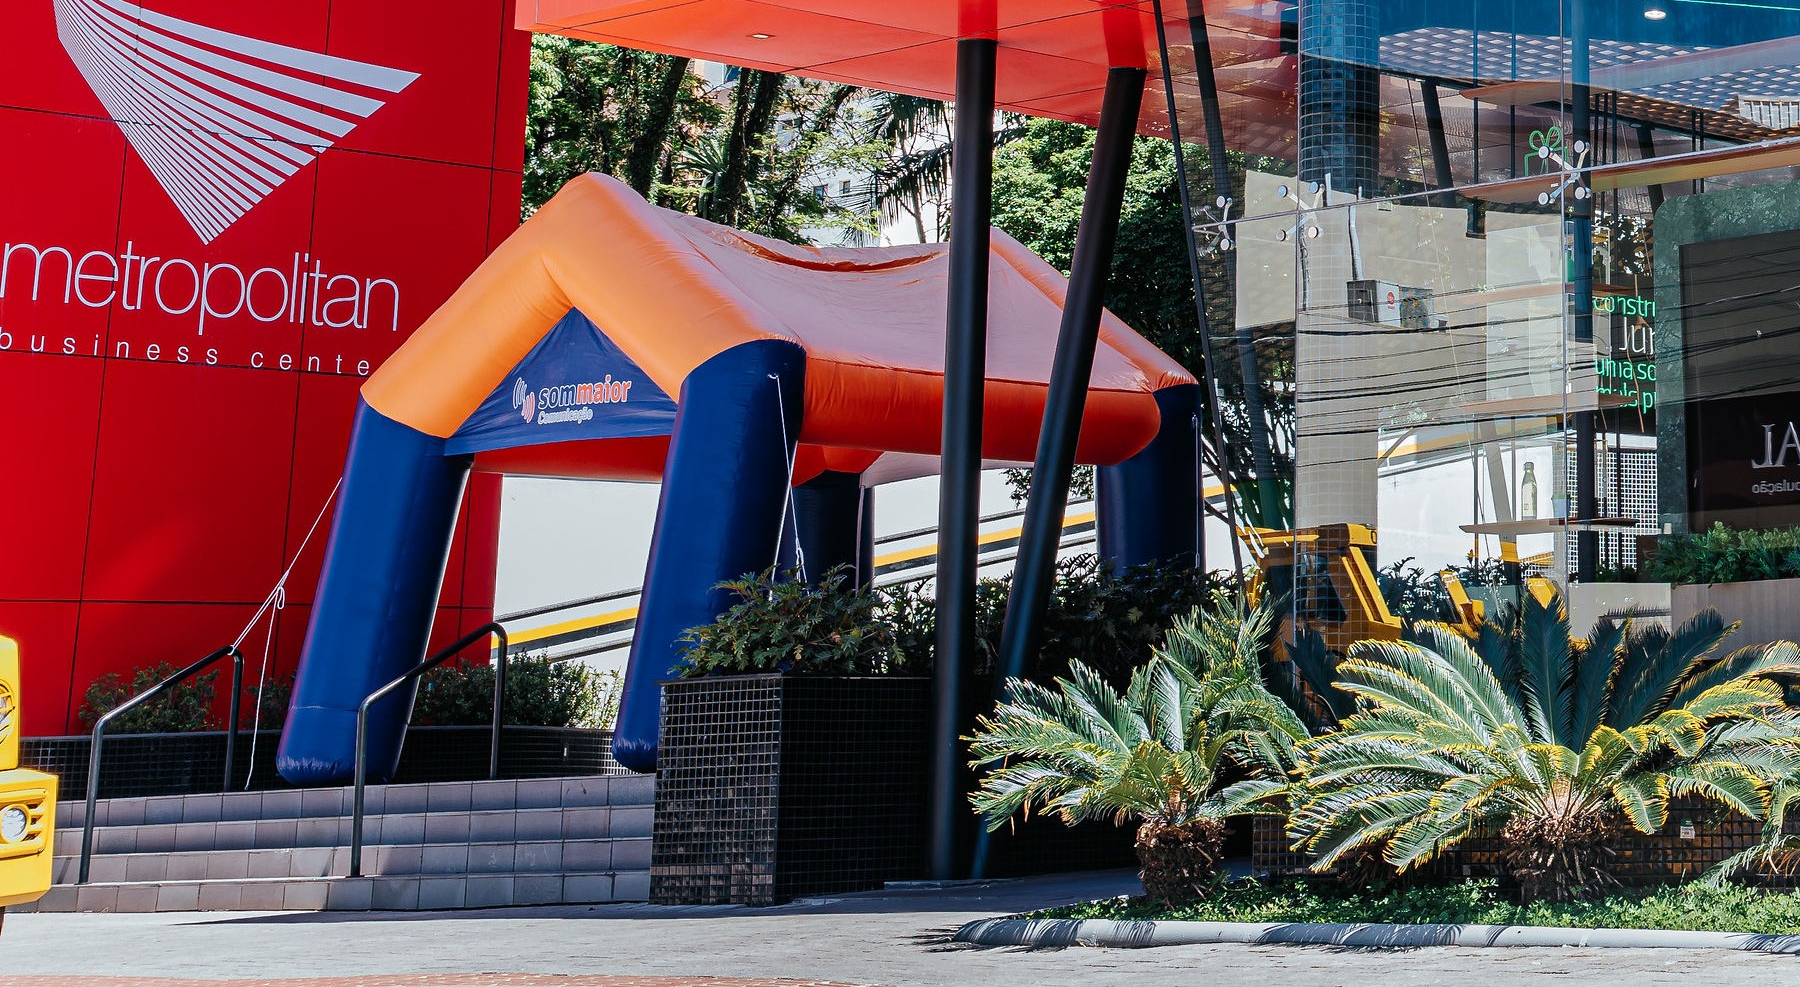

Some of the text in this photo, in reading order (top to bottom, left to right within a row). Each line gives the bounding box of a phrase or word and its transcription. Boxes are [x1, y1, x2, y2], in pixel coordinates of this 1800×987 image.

[0, 241, 400, 336] metropolitan
[0, 327, 373, 375] business cente
[537, 374, 632, 410] sommaior
[537, 408, 593, 425] Comunicação
